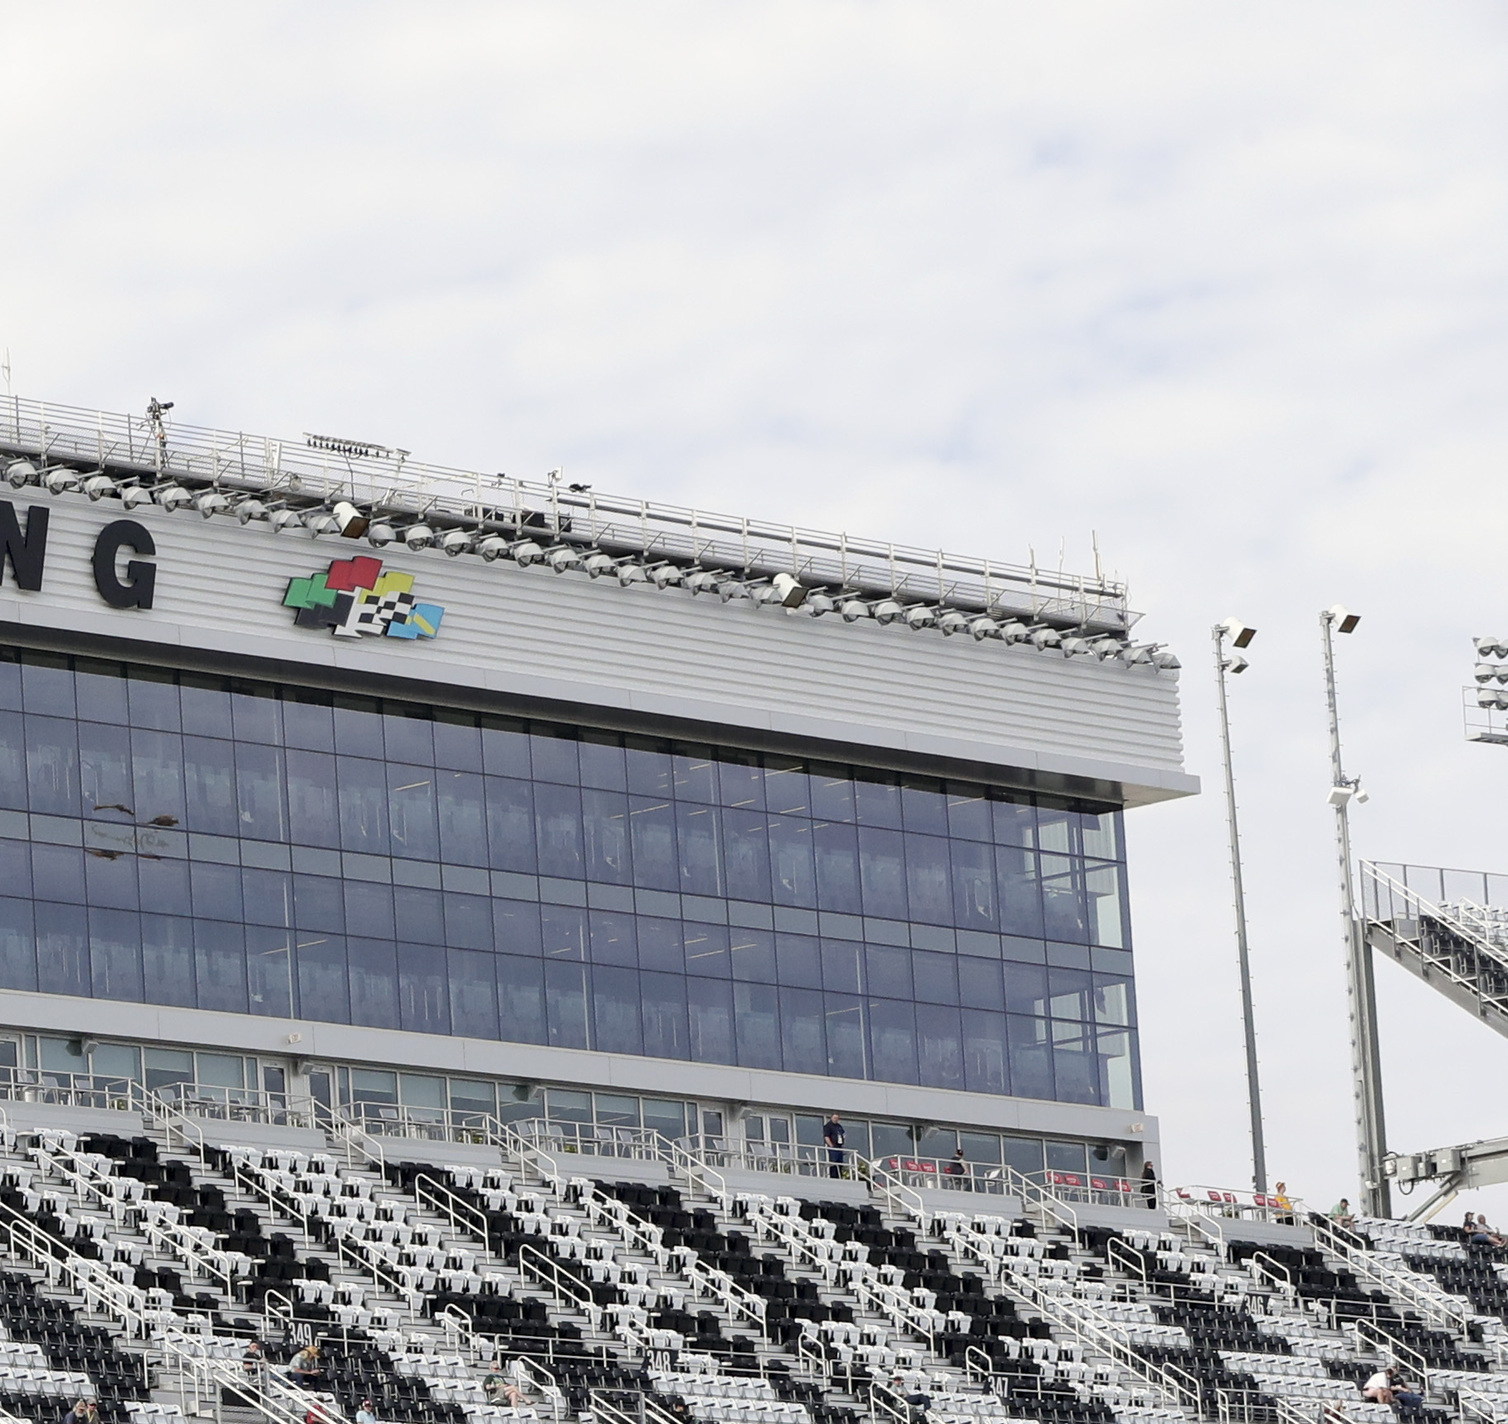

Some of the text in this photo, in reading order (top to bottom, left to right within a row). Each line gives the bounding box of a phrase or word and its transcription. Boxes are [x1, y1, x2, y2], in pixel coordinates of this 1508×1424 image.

[1244, 1295, 1264, 1317] 346
[288, 1321, 312, 1346] 349
[647, 1350, 672, 1373] 348
[988, 1376, 1009, 1398] 347
